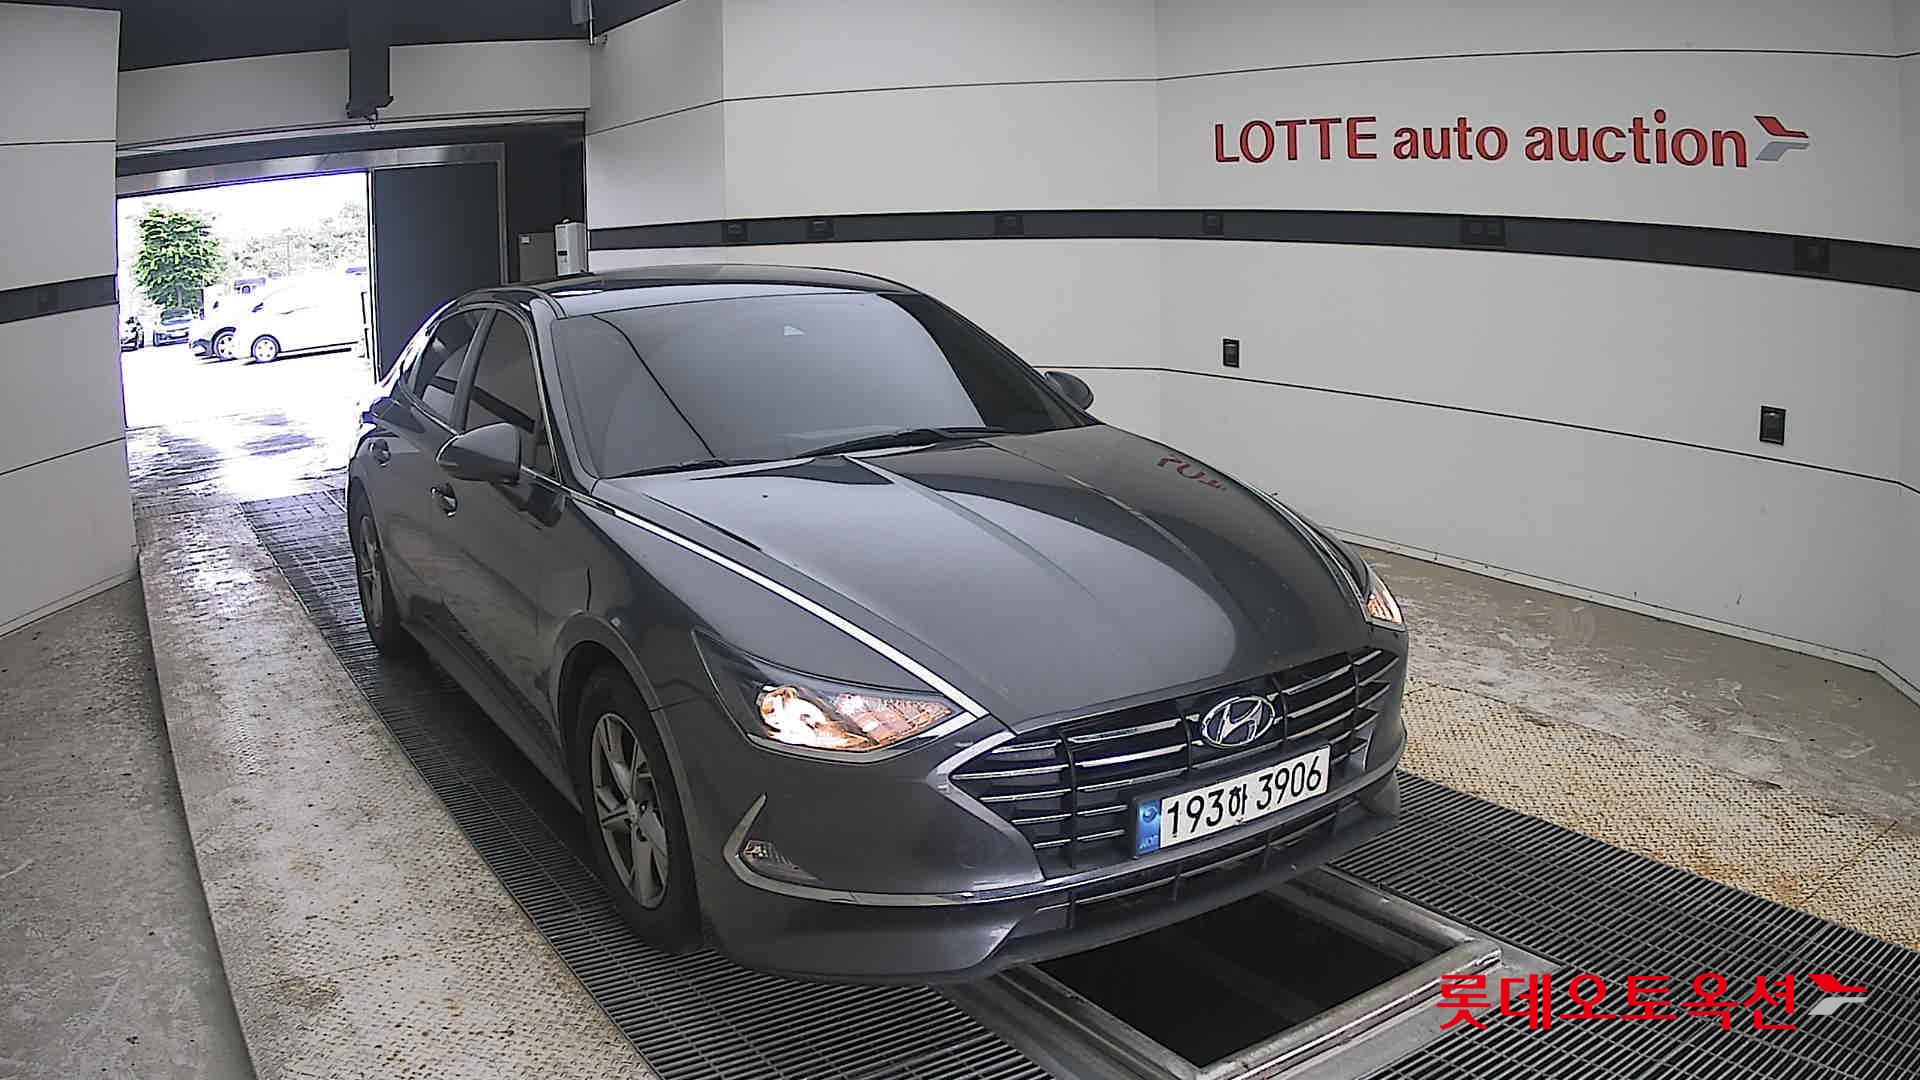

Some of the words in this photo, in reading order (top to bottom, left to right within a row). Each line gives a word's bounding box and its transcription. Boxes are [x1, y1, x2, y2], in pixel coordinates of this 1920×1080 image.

[1215, 116, 1378, 164] LOTTE
[1393, 117, 1508, 161] auto
[1524, 109, 1749, 168] auction
[1167, 783, 1248, 838] 193하
[1256, 755, 1322, 811] 3906
